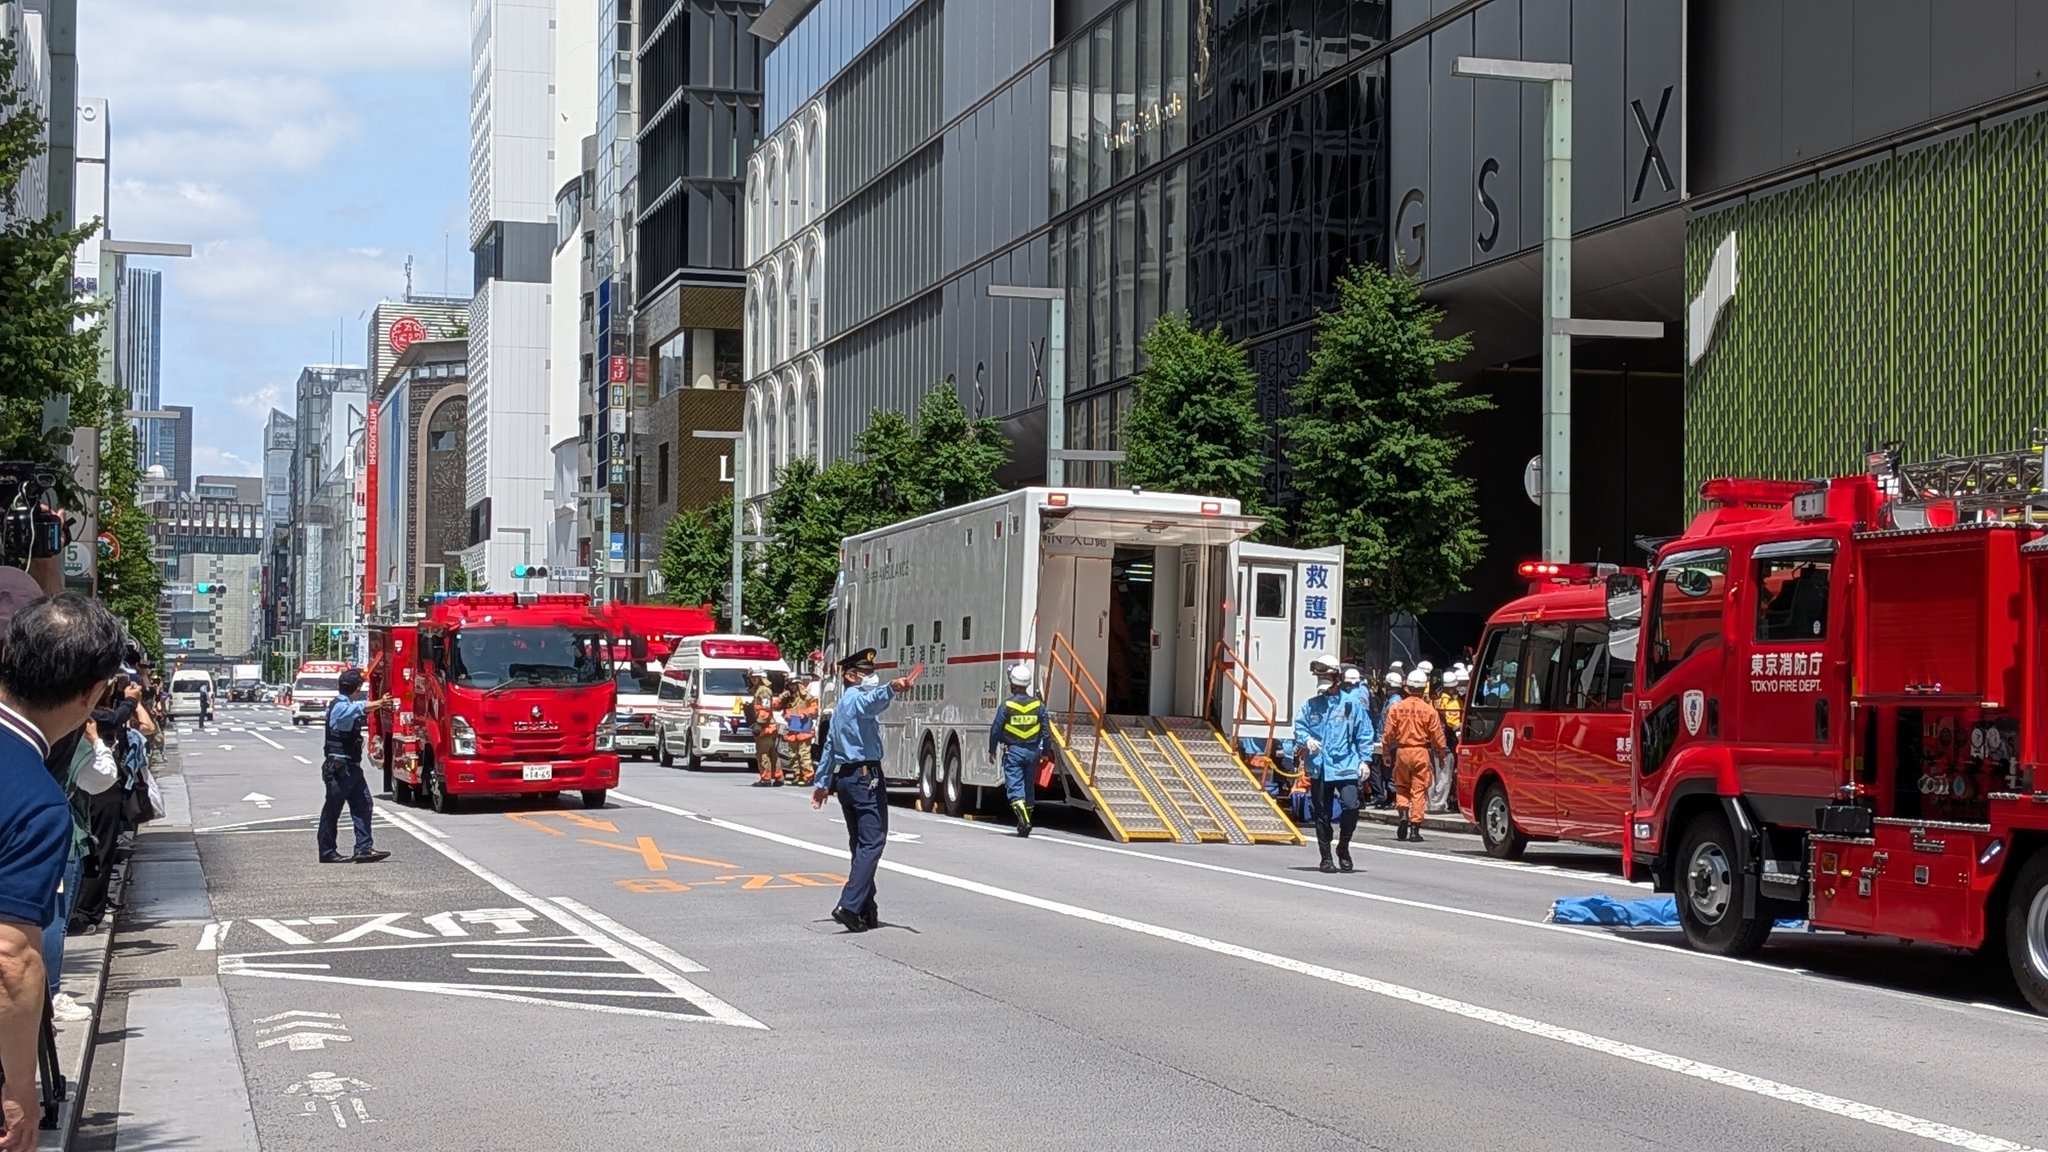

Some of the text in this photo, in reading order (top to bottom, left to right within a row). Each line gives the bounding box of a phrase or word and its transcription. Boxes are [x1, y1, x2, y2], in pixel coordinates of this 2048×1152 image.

[368, 408, 378, 465] MITSUKOSHI
[1303, 565, 1328, 650] 救護所
[1751, 652, 1823, 676] 東京消防庁
[1751, 679, 1822, 692] TOKYO FIRE DEPT.
[196, 907, 540, 951] バス停
